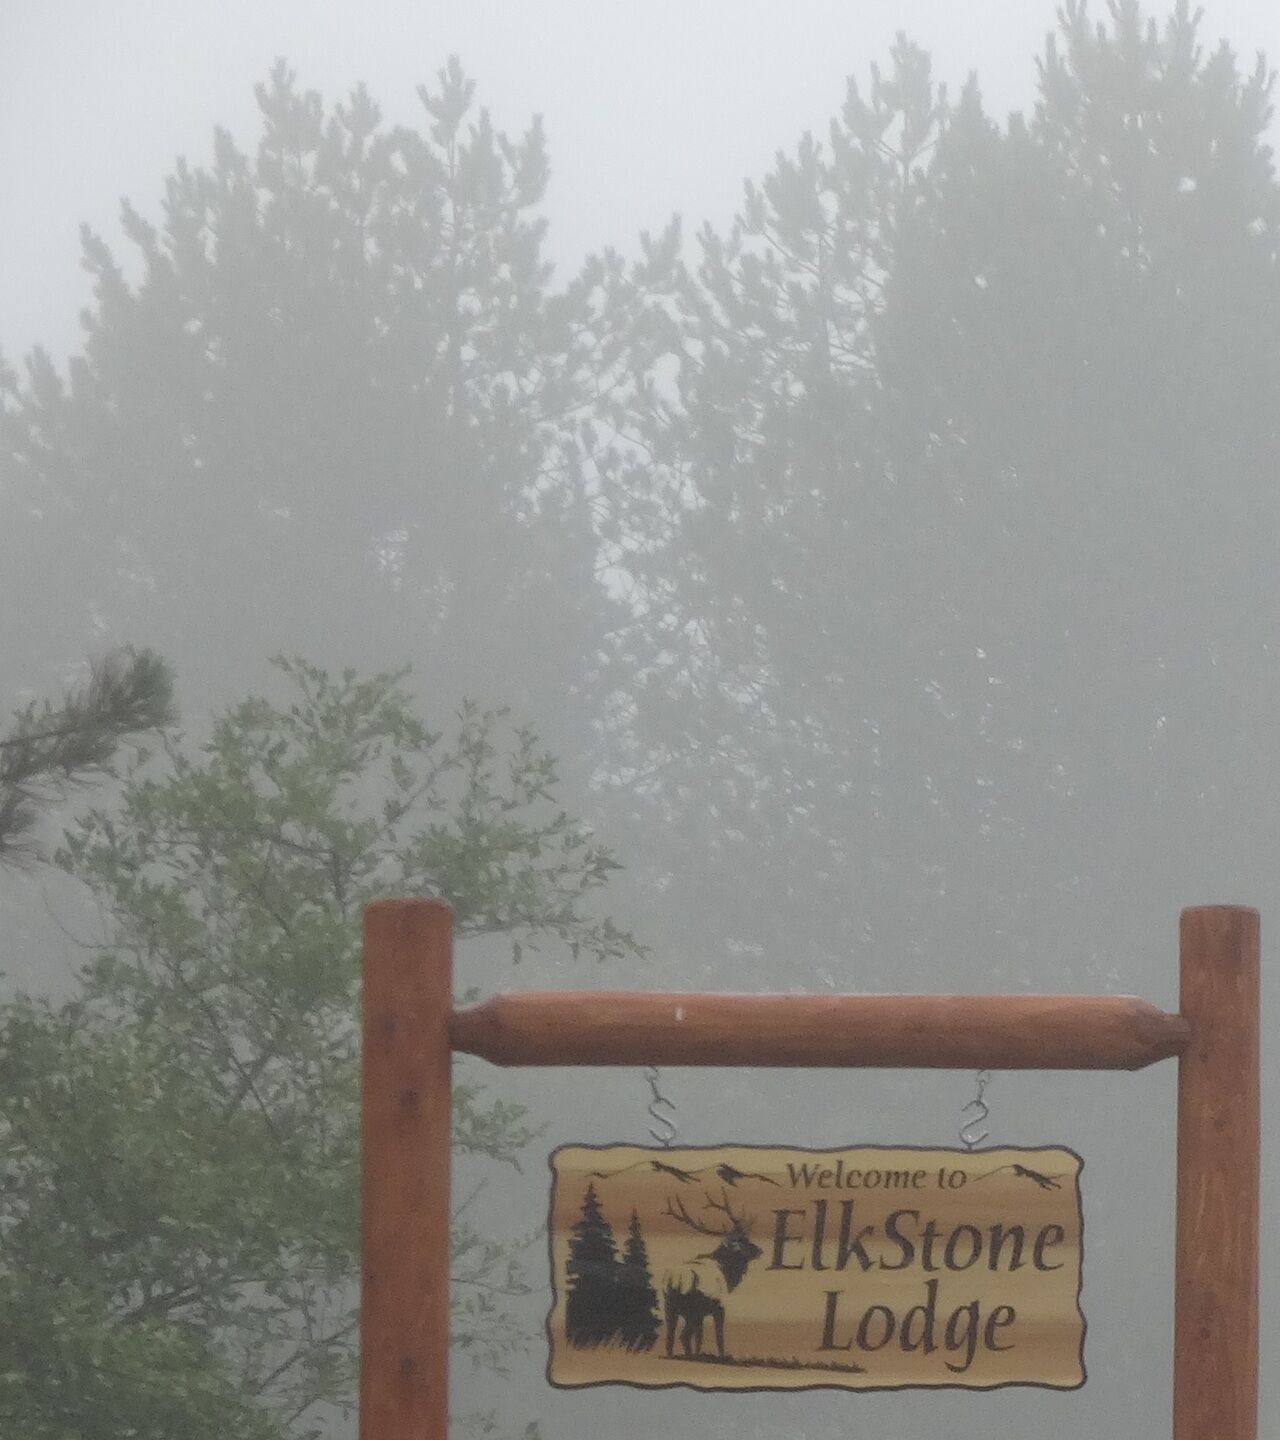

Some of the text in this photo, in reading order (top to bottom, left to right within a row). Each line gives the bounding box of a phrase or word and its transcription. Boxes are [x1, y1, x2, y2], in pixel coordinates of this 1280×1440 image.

[786, 1160, 967, 1190] Welcome to
[765, 1199, 1066, 1272] ElkStone
[817, 1279, 1017, 1373] Lodge
